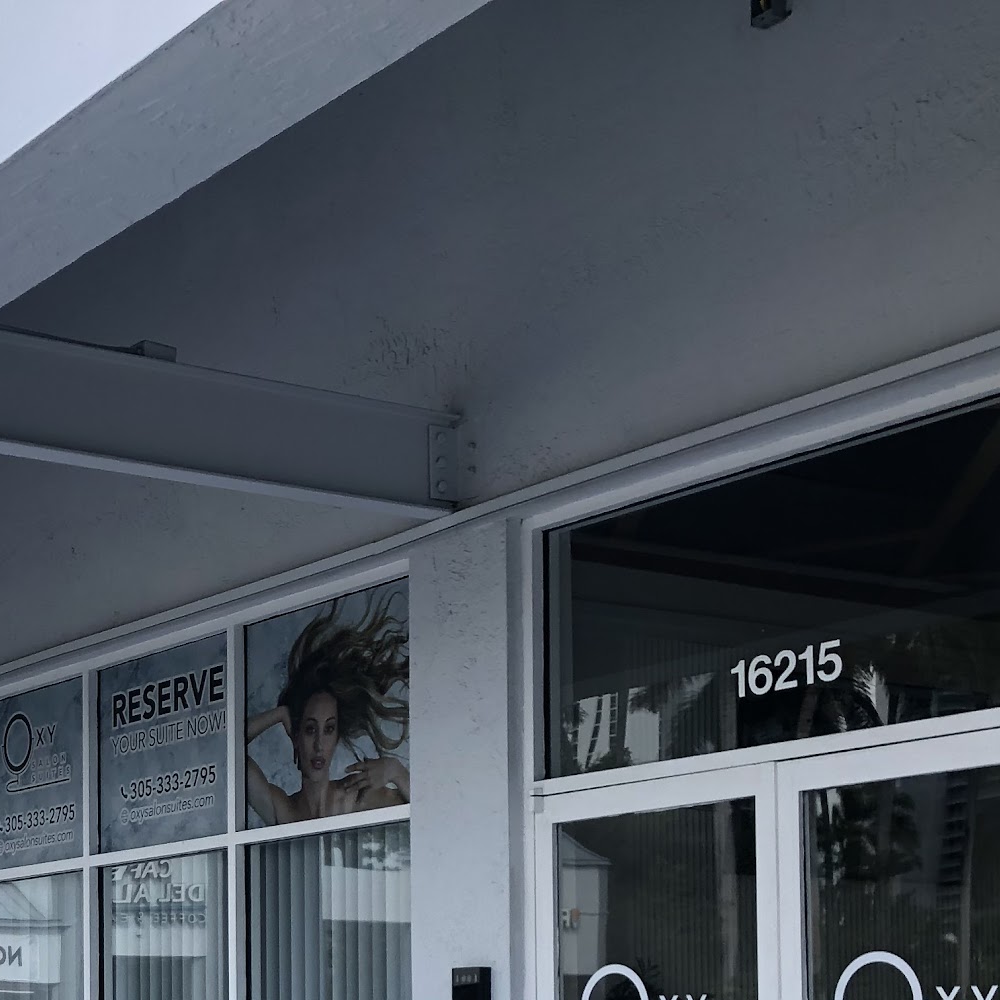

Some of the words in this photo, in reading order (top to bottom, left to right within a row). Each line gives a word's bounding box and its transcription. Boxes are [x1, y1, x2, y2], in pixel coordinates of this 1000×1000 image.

[730, 639, 843, 698] 16215
[112, 665, 224, 728] RESERVE
[111, 731, 146, 755] YOUR
[149, 721, 184, 747] SUITE
[187, 710, 227, 738] NOW!
[31, 753, 67, 769] SALON
[31, 766, 71, 782] SUITES
[130, 765, 216, 800] 305-333-2795
[5, 803, 75, 833] 305-333-2795
[130, 795, 214, 823] oxysalonsuites.com
[4, 831, 74, 852] oxysalonsuites.com
